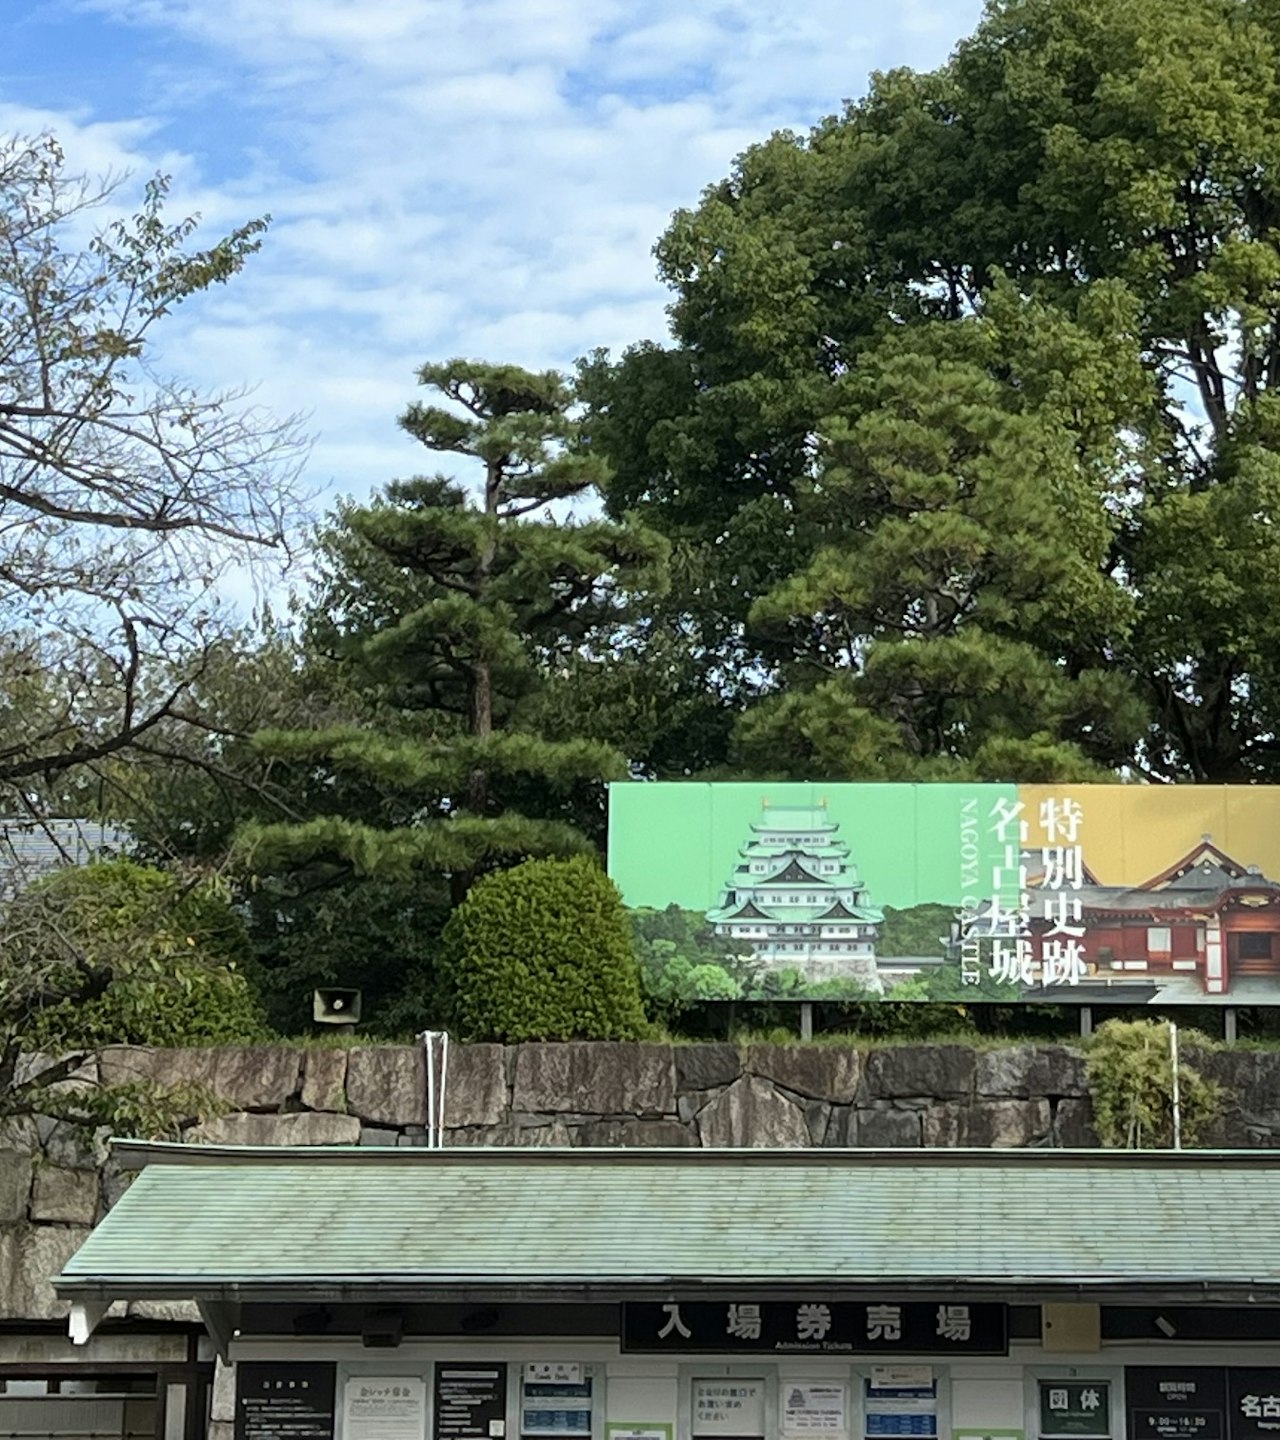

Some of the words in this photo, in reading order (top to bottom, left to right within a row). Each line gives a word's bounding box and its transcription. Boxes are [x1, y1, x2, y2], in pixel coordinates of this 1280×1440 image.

[960, 797, 979, 888] NAGOYA
[987, 797, 1035, 986] 名古屋城
[1039, 797, 1087, 987] 特別史跡
[960, 895, 981, 986] CASTLE
[657, 1304, 972, 1341] 入場券売場
[1049, 1388, 1100, 1410] 団体
